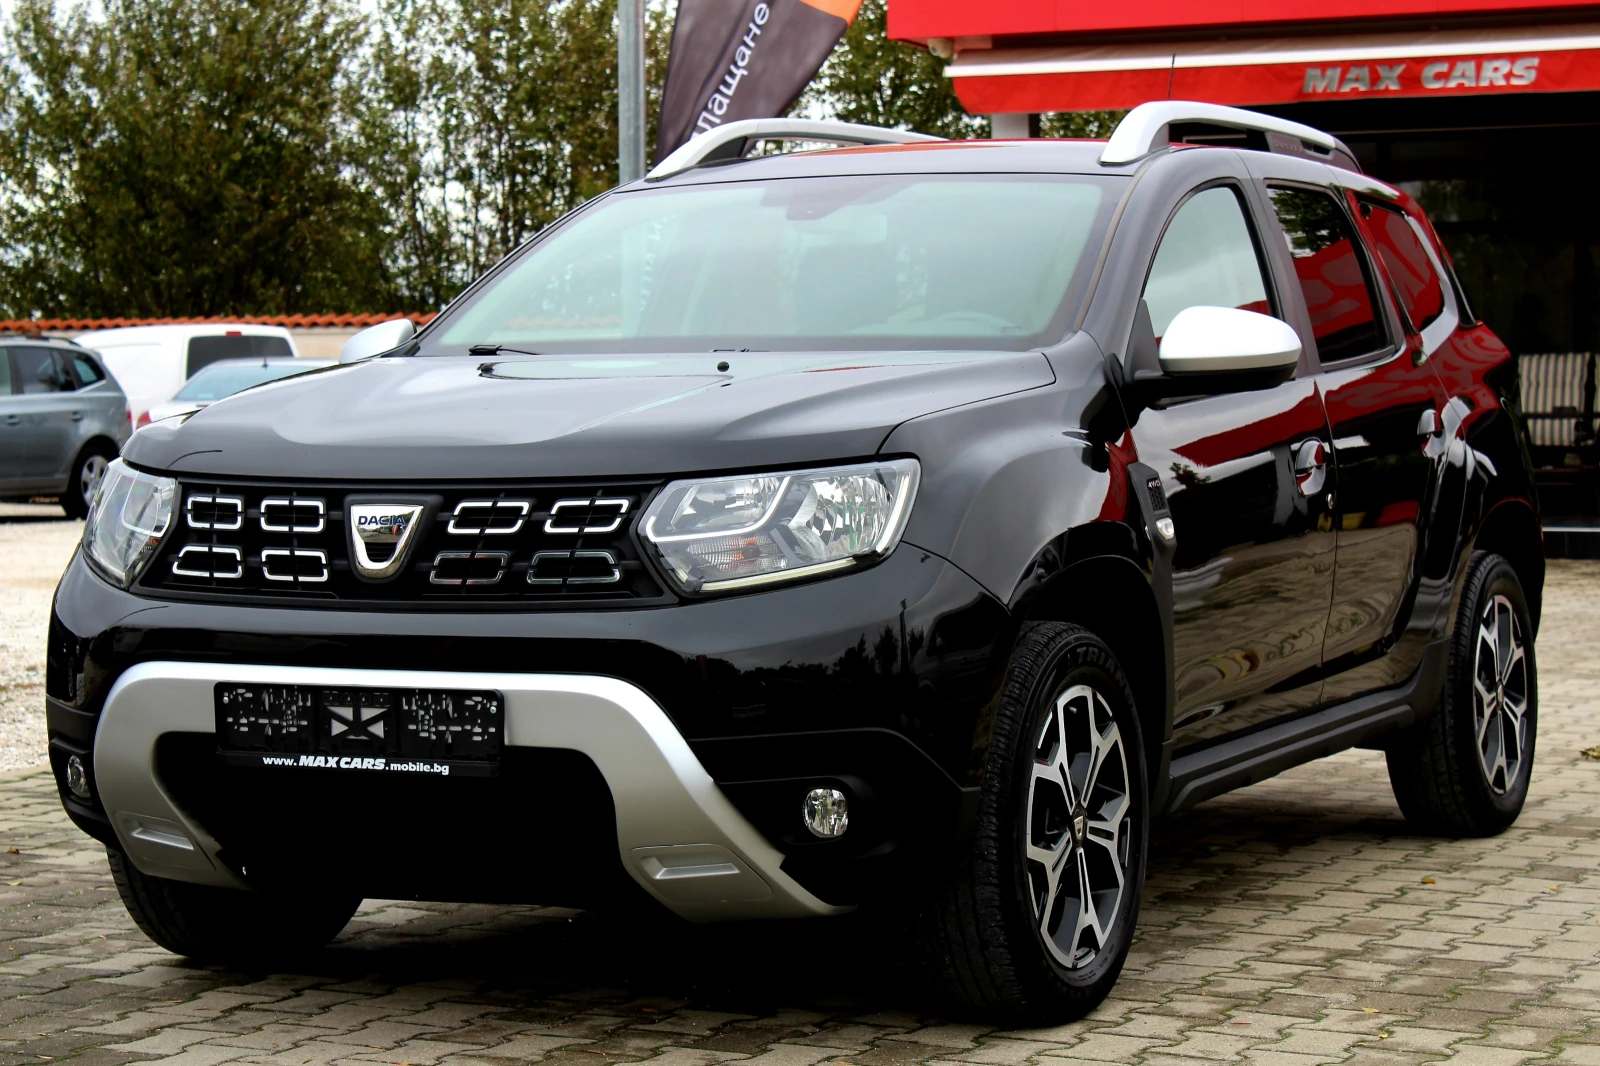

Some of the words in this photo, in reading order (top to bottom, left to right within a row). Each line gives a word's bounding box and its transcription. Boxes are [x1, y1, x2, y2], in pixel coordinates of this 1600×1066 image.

[1303, 64, 1406, 94] MAX
[1421, 57, 1540, 89] CARS
[1148, 480, 1161, 488] 4WD
[358, 515, 405, 526] DACIA
